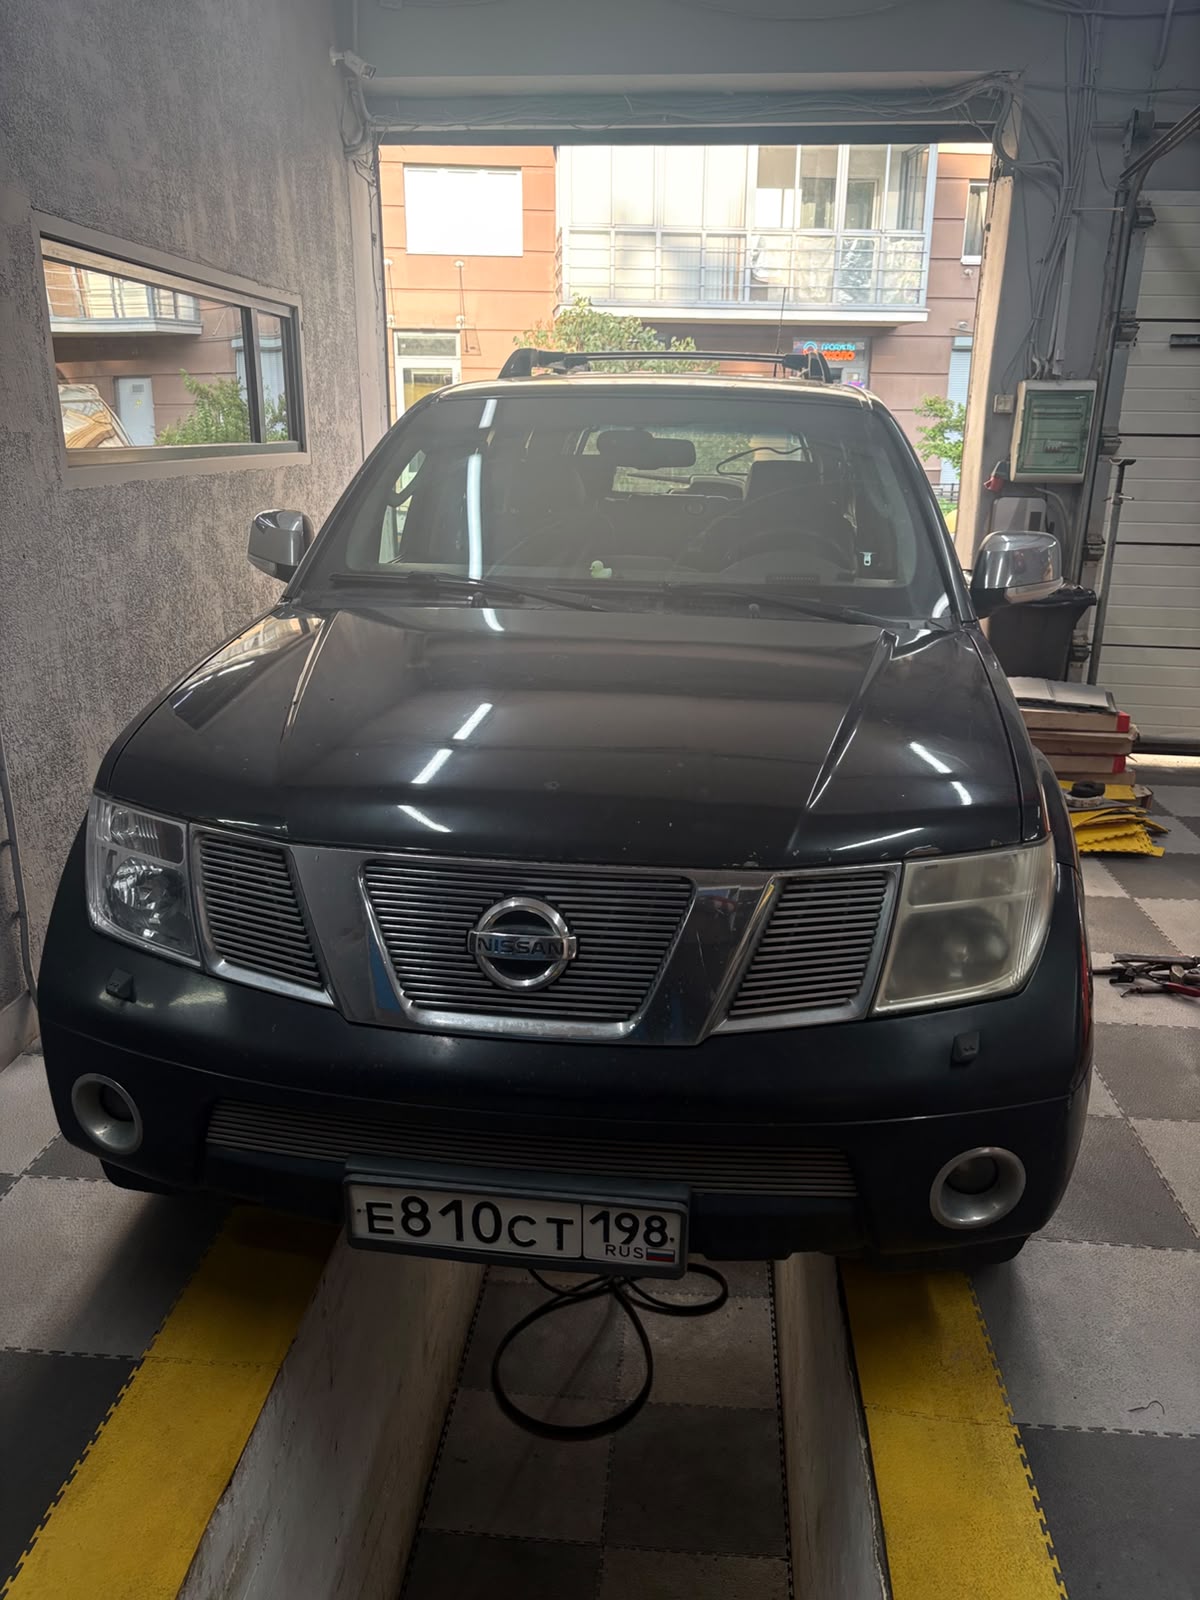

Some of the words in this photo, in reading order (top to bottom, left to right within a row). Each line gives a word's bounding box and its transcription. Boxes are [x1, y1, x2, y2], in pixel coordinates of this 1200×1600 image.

[478, 937, 564, 956] NISSAN
[365, 1196, 575, 1251] E810CT
[589, 1211, 669, 1248] 198
[604, 1244, 645, 1259] RUS
